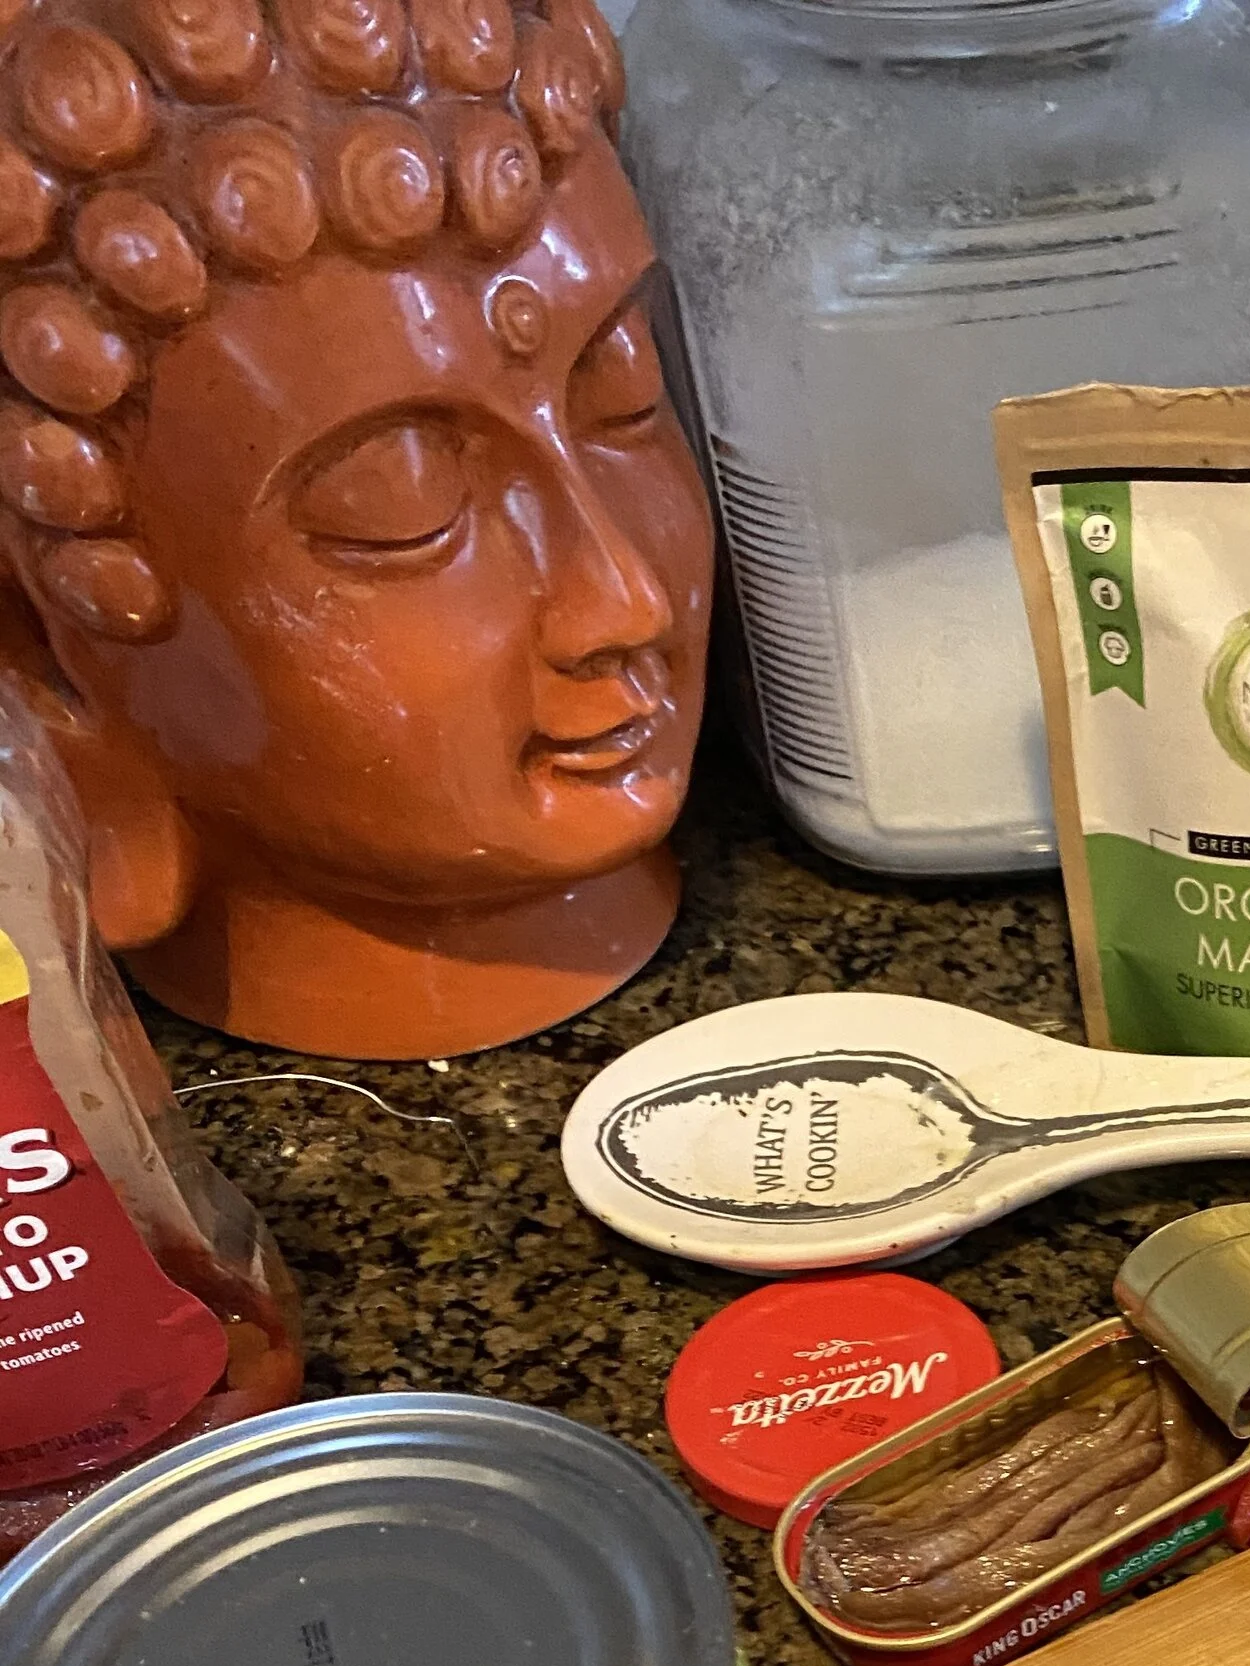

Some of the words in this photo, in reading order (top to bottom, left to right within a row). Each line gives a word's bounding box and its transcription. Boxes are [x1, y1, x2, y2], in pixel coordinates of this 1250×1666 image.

[752, 1096, 794, 1195] WHAT'S
[805, 1091, 839, 1193] COOKIN'
[19, 1311, 85, 1342] ripened
[0, 1340, 81, 1371] tomatoes
[814, 1356, 883, 1379] FAMILY
[727, 1352, 948, 1428] Mezzetta
[1021, 1590, 1087, 1638] OSCAR
